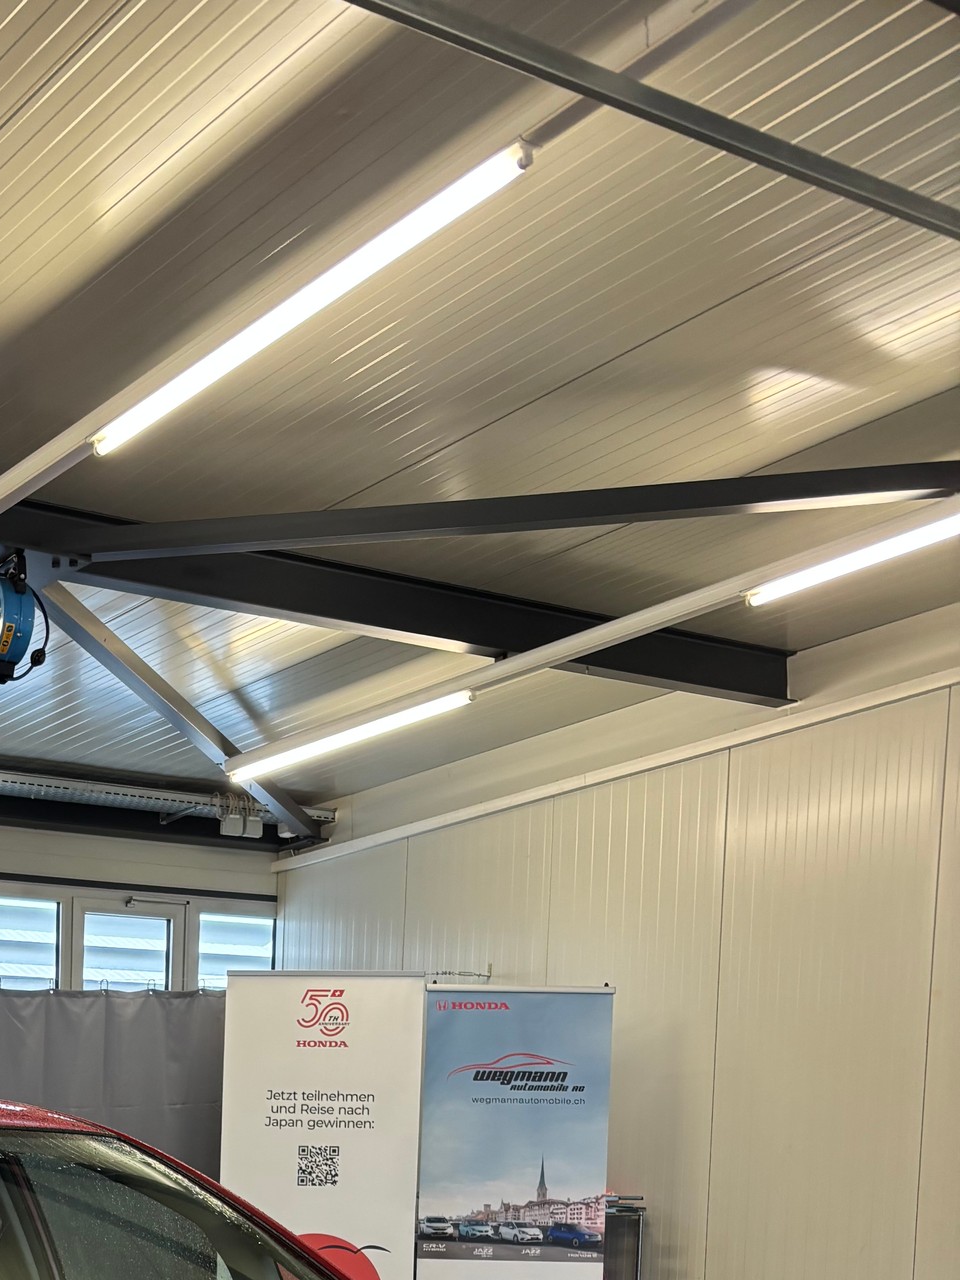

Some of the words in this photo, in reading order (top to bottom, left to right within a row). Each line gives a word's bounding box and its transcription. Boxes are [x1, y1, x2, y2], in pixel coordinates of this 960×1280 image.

[451, 1001, 510, 1010] HONDA
[296, 989, 349, 1036] 50
[296, 1040, 348, 1048] HONDA
[473, 1070, 568, 1085] wegmann
[266, 1089, 298, 1101] Jetzt
[301, 1090, 375, 1102] teilnehmen
[471, 1096, 585, 1105] wegmannautomobile.ch
[271, 1103, 296, 1114] und
[300, 1103, 335, 1115] Reise
[338, 1104, 370, 1115] nach
[265, 1116, 303, 1130] Japan
[307, 1117, 375, 1131] gewinnen:
